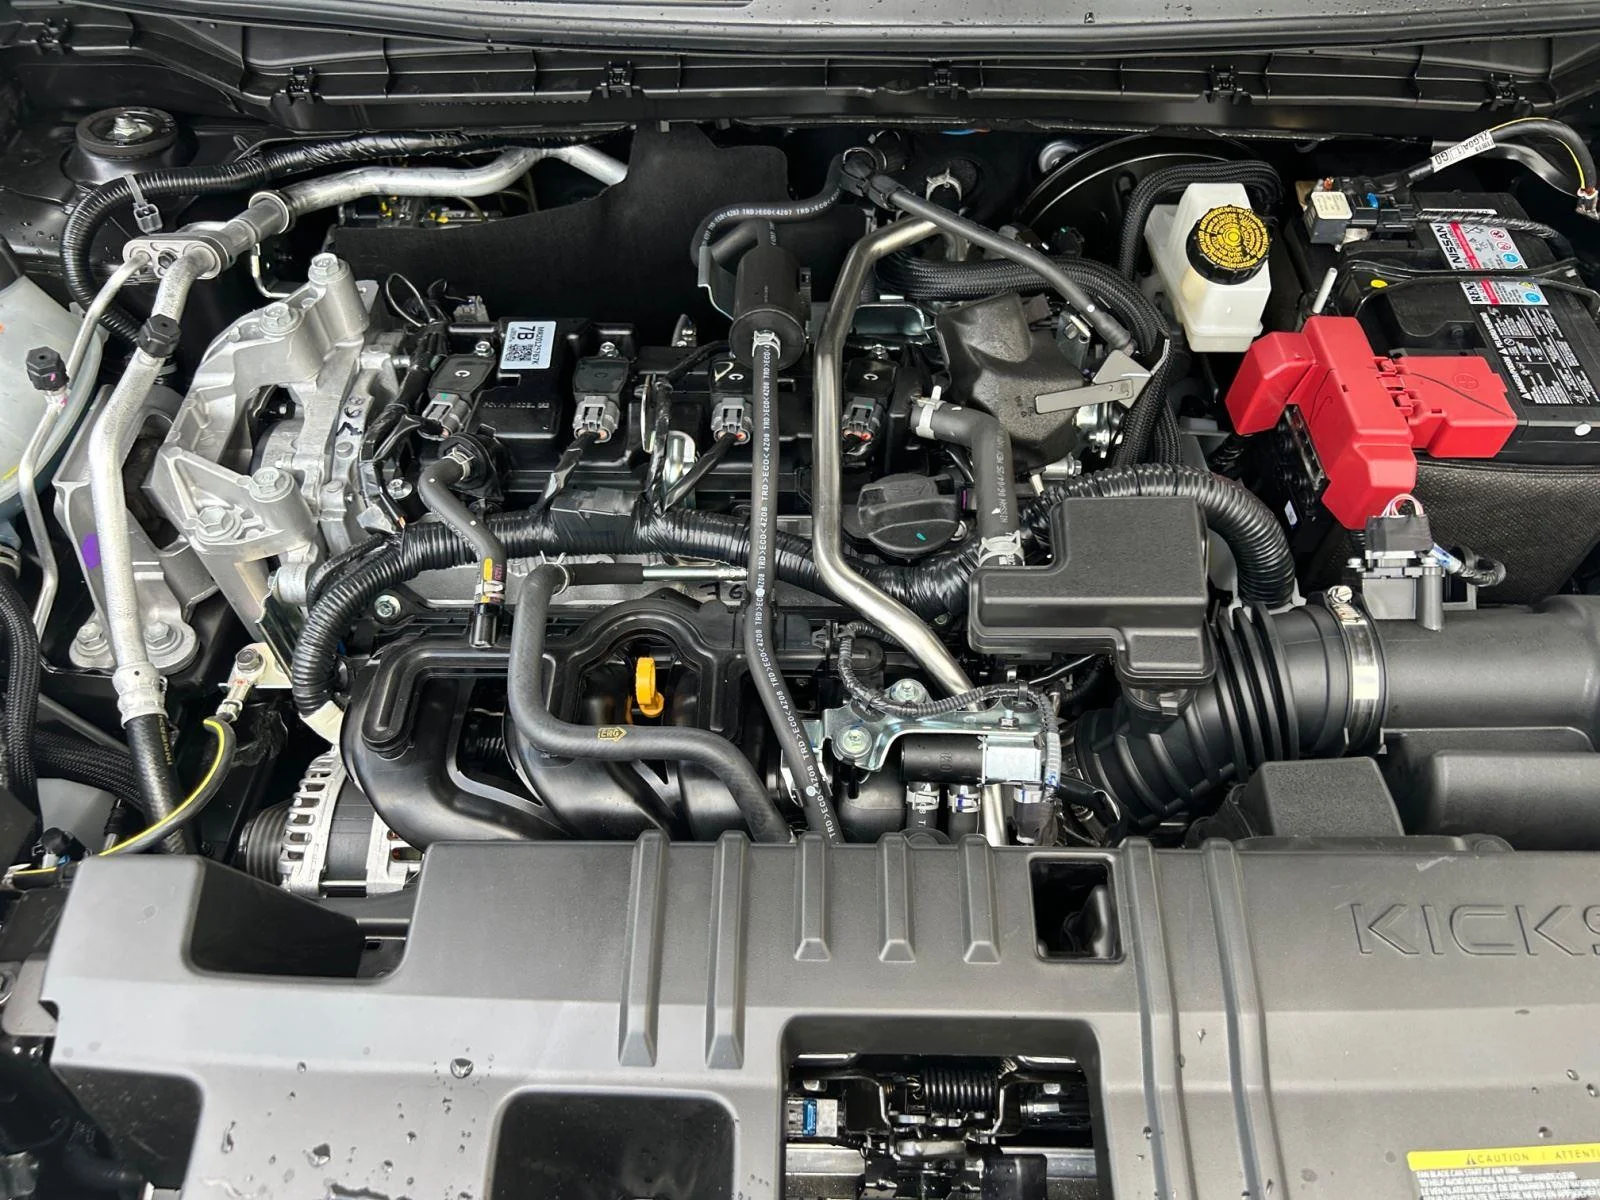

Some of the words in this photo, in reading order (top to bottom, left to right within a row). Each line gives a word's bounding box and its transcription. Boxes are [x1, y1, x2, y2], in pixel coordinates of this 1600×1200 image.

[1434, 224, 1463, 264] NISSAN
[517, 326, 536, 340] 7B
[1477, 1152, 1530, 1164] CAUTION
